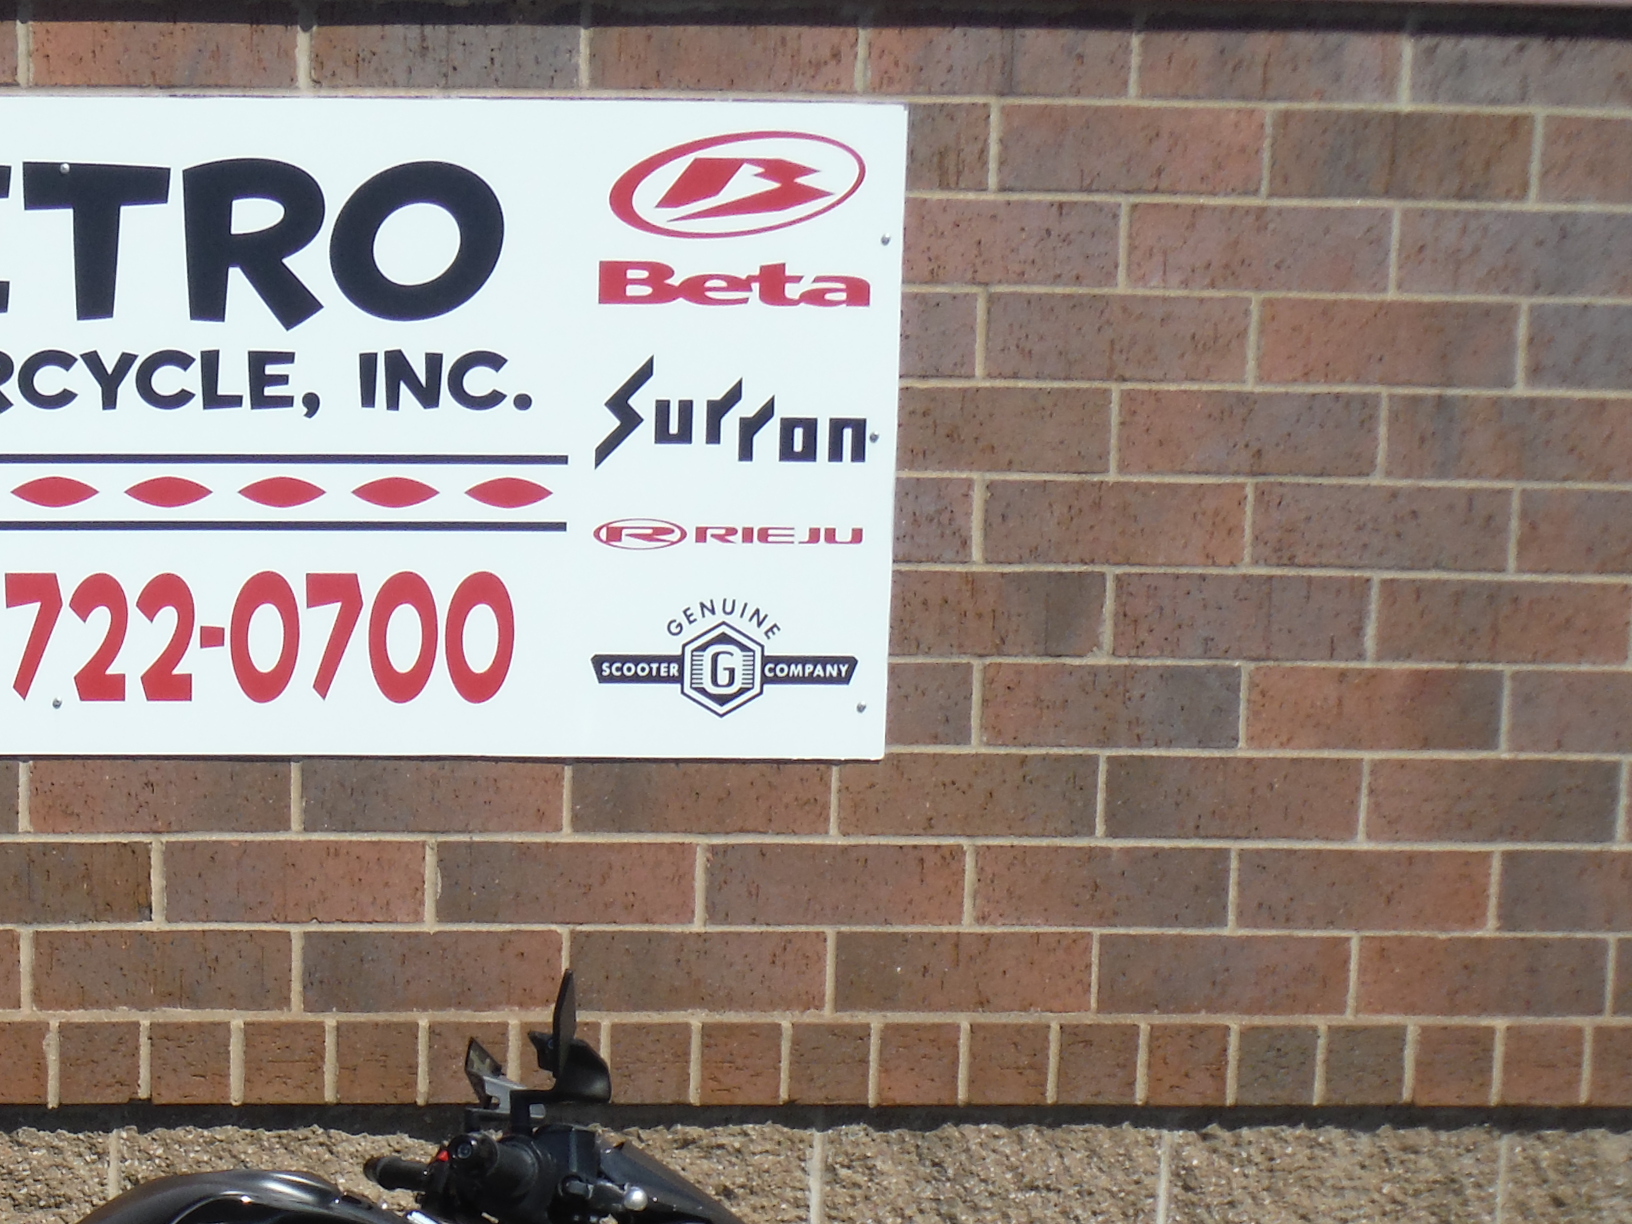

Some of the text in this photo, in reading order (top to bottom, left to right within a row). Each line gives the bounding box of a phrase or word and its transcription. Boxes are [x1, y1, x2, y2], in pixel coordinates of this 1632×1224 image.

[599, 261, 870, 306] Beta
[359, 350, 532, 411] INC.
[595, 356, 866, 469] Surron
[696, 527, 863, 544] RIEJU
[4, 571, 515, 704] 722-0700
[666, 597, 781, 639] GENUINE
[602, 663, 678, 676] SCOOTER
[765, 664, 848, 677] COMPANY
